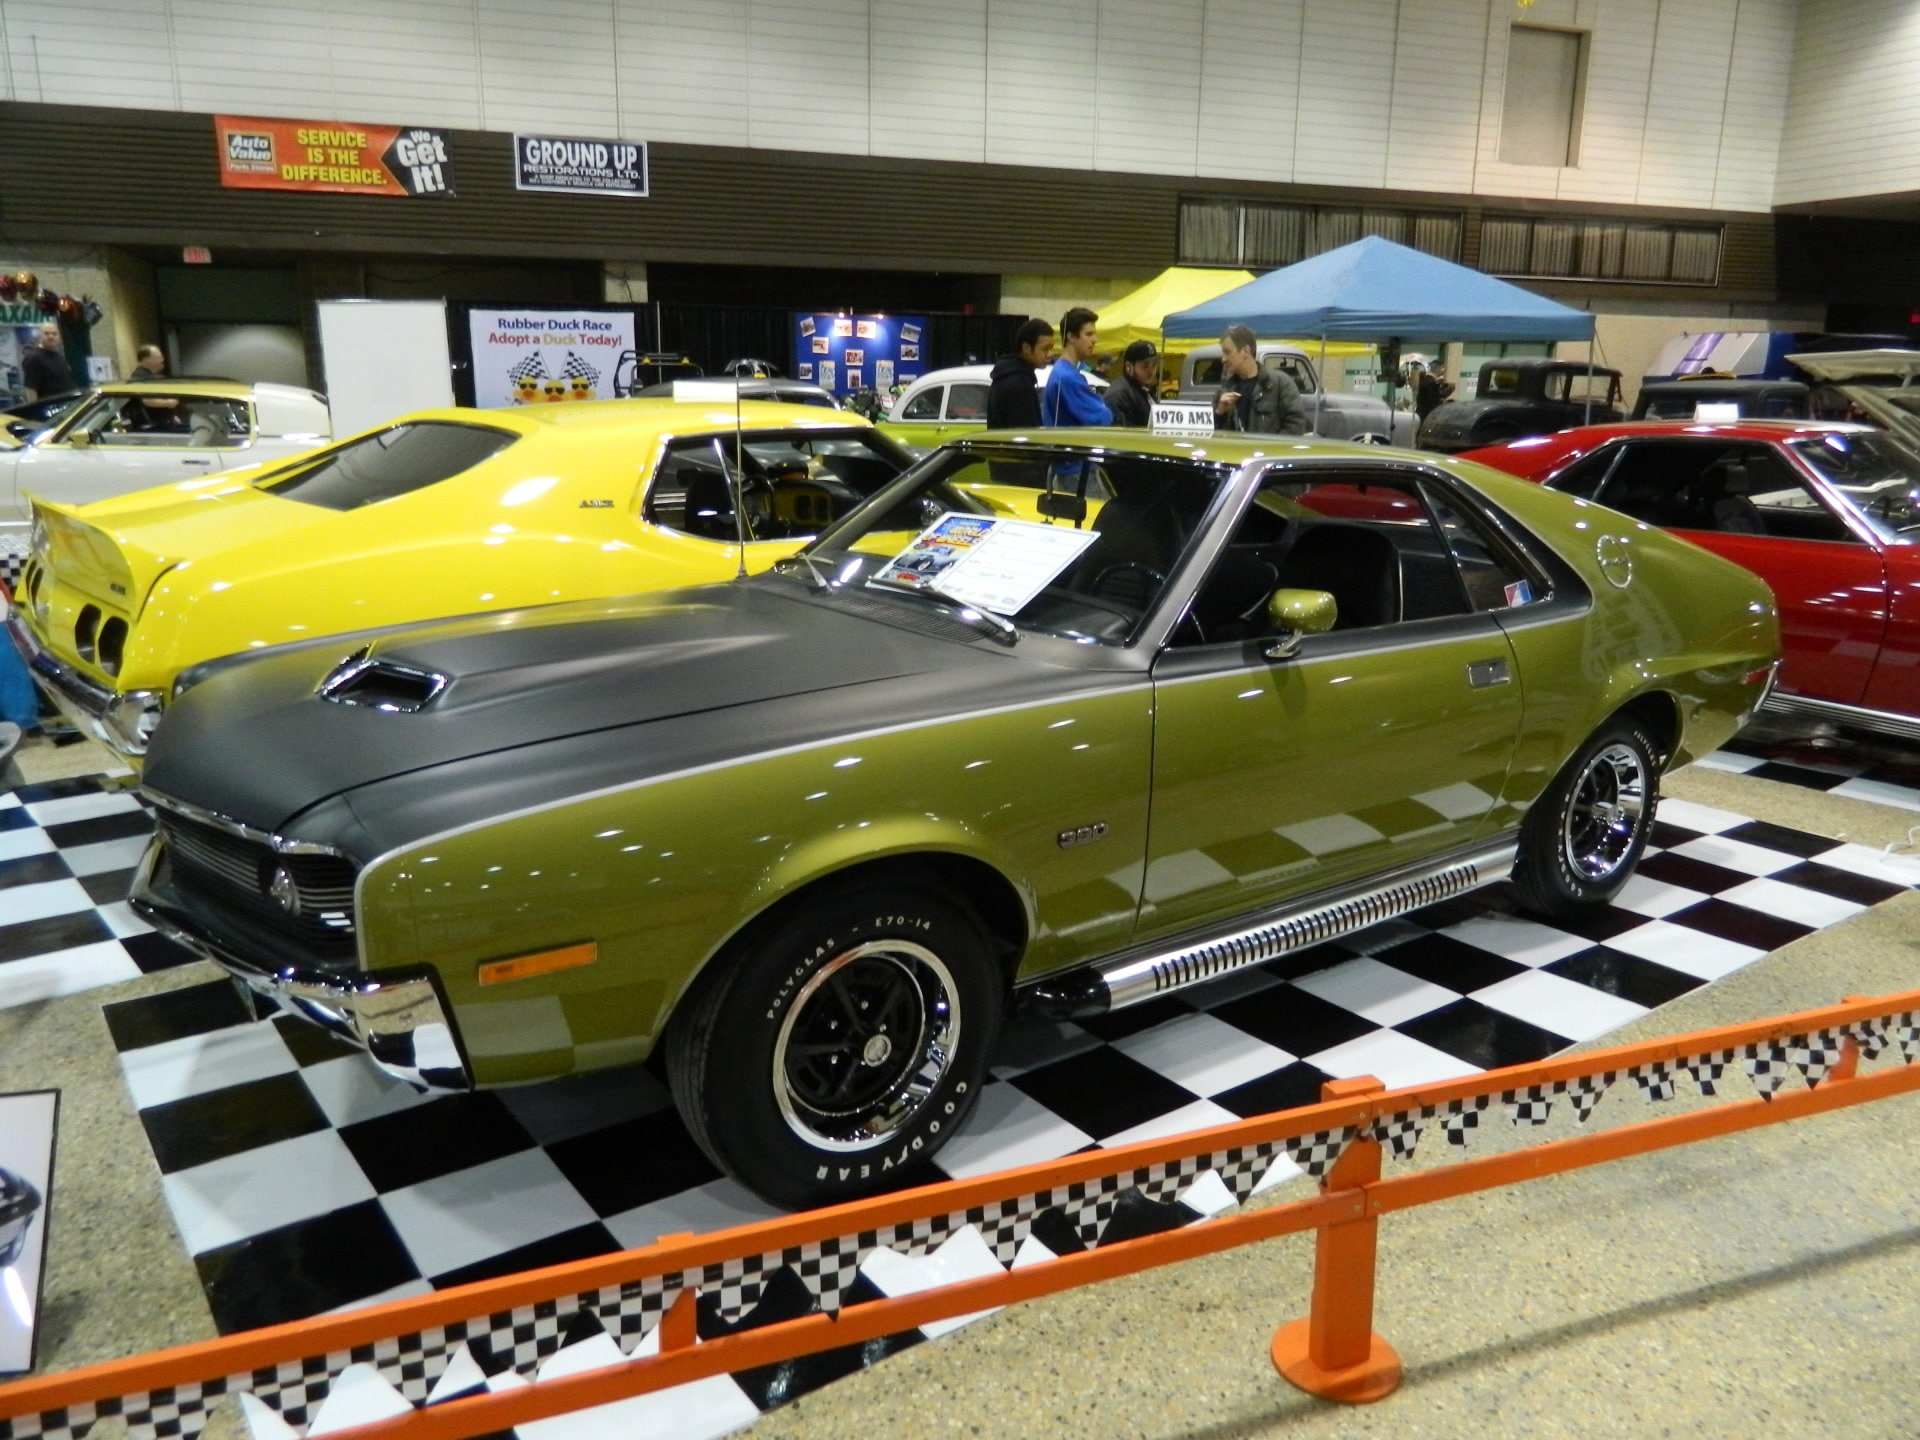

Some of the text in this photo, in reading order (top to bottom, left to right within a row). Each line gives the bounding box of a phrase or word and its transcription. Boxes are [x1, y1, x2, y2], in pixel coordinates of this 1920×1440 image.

[231, 135, 269, 149] Auto
[297, 129, 367, 149] SERVICE
[410, 130, 431, 144] We
[229, 146, 272, 161] Value
[307, 148, 360, 166] IS THE
[396, 135, 448, 167] Get
[526, 139, 637, 170] GROUND UP
[282, 164, 388, 185] DIFFERENCE.
[411, 162, 446, 194] It!
[523, 163, 641, 179] RESTORATIONS LTD.
[497, 318, 612, 330] Rubber Duck Race
[488, 332, 622, 348] Adopt a Duck Today!
[1155, 411, 1213, 425] 1970 AMX
[875, 916, 932, 931] E70-14
